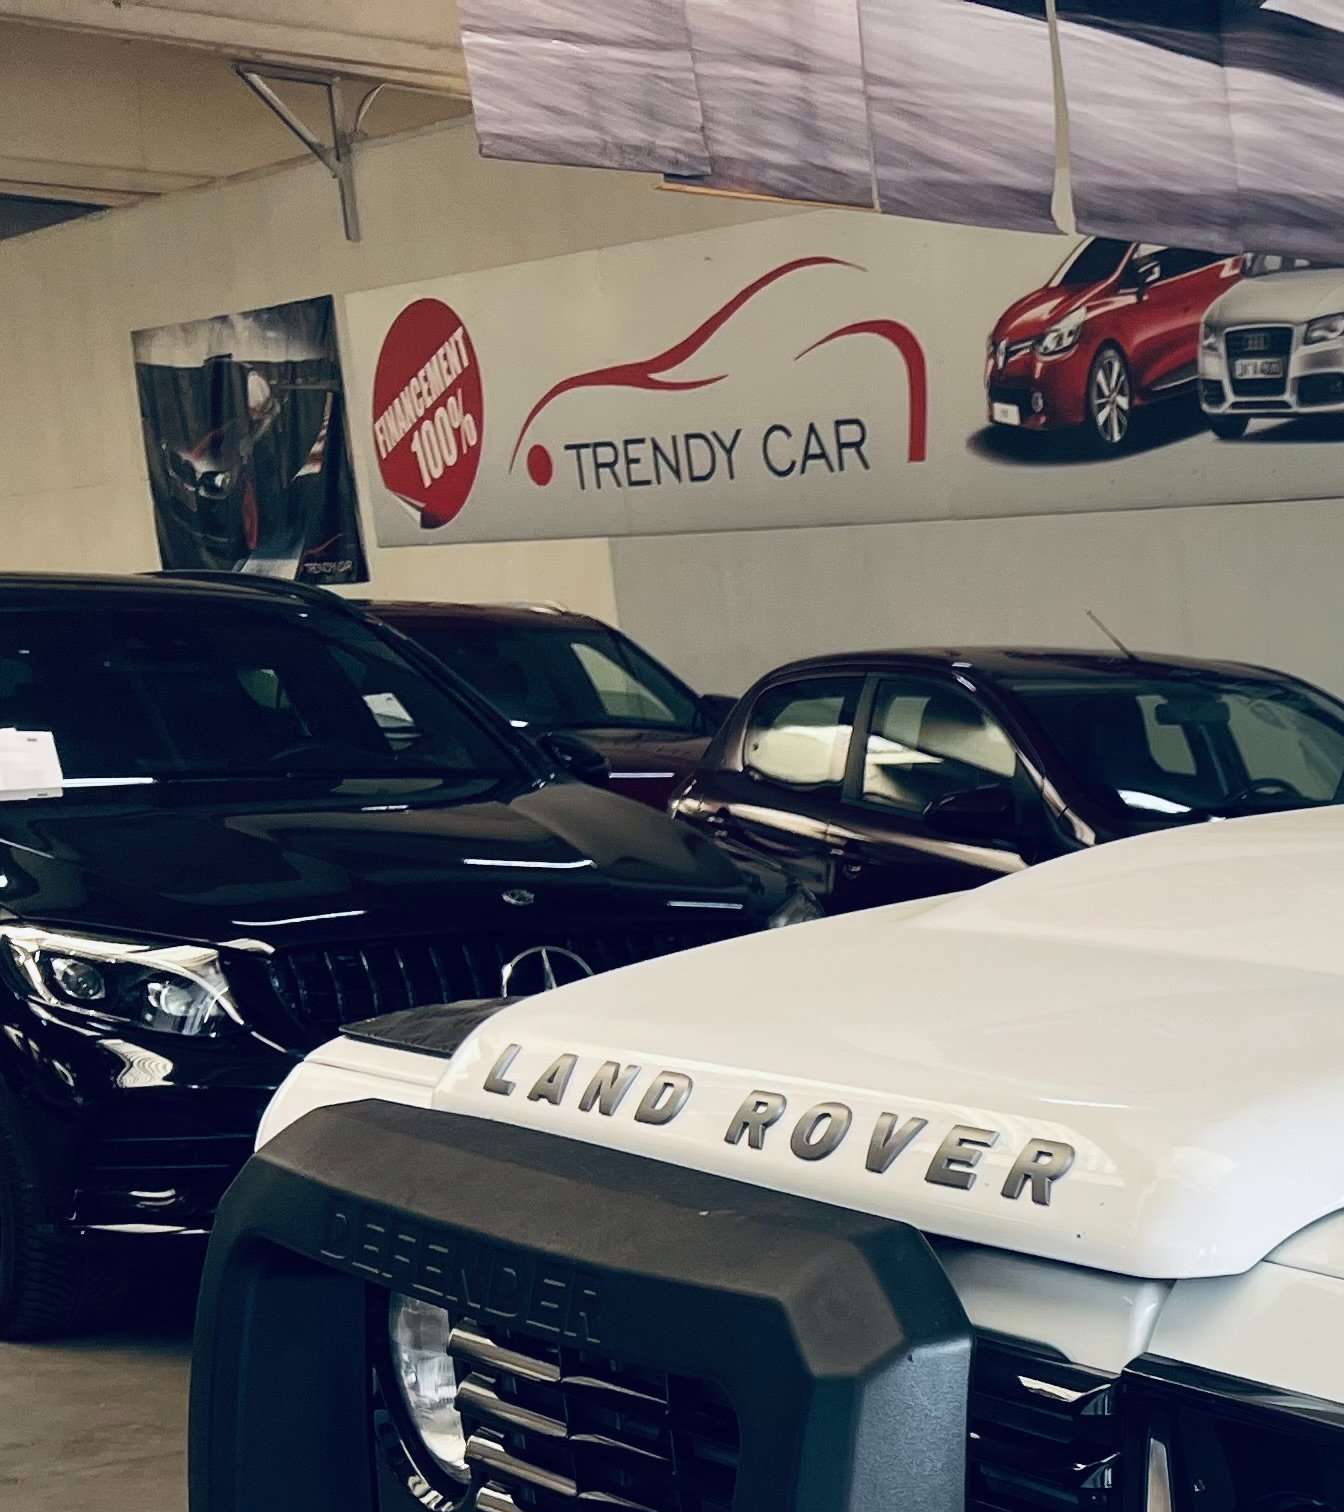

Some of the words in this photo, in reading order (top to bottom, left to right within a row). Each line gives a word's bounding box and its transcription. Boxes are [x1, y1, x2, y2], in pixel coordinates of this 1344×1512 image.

[373, 325, 470, 460] FINANCEMENT
[410, 387, 478, 489] 100%
[564, 428, 742, 490] TRENDY
[762, 418, 871, 478] CAR
[483, 1042, 694, 1127] LAND
[723, 1088, 1077, 1207] ROVER
